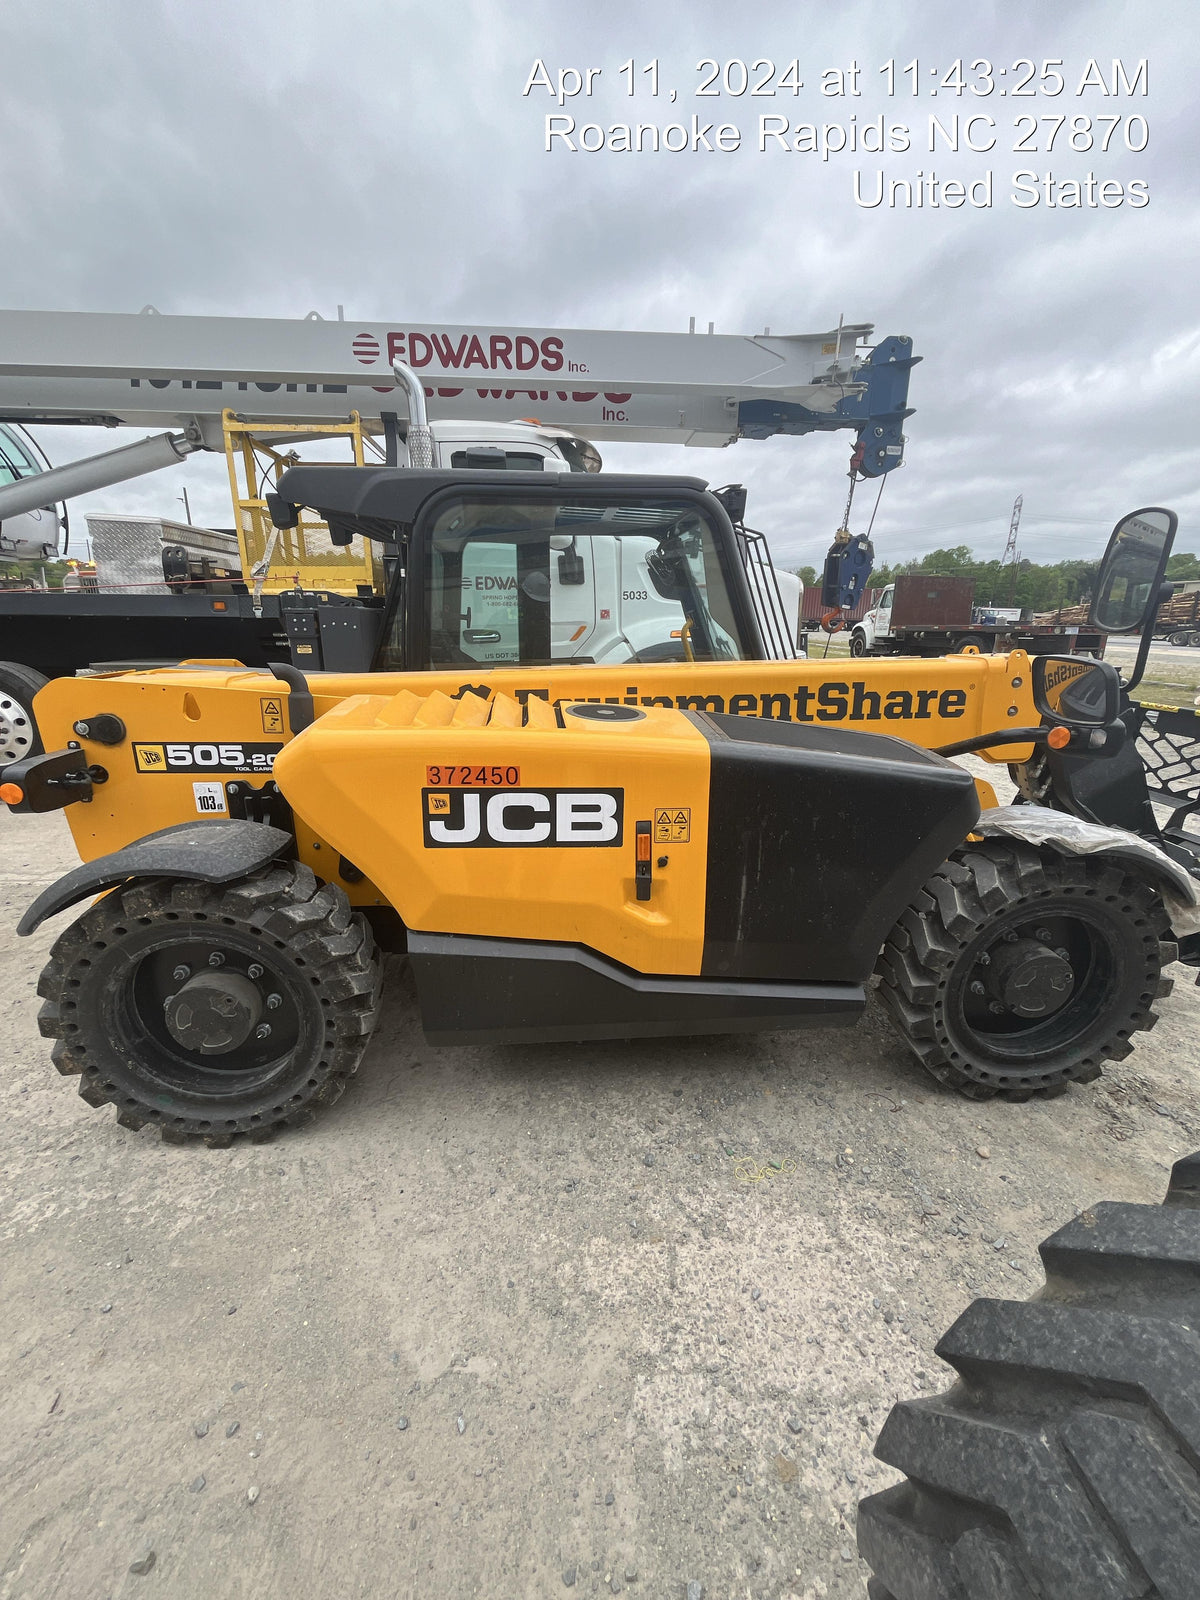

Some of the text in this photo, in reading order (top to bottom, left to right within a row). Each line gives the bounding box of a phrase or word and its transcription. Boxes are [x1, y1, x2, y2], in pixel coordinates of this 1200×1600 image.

[387, 332, 590, 373] EDWARDS Inc.
[602, 406, 629, 421] Inc.
[475, 576, 518, 591] EDWA
[622, 590, 648, 600] 5033
[429, 766, 519, 785] 372450
[198, 796, 217, 811] 103
[429, 793, 619, 843] JCB
